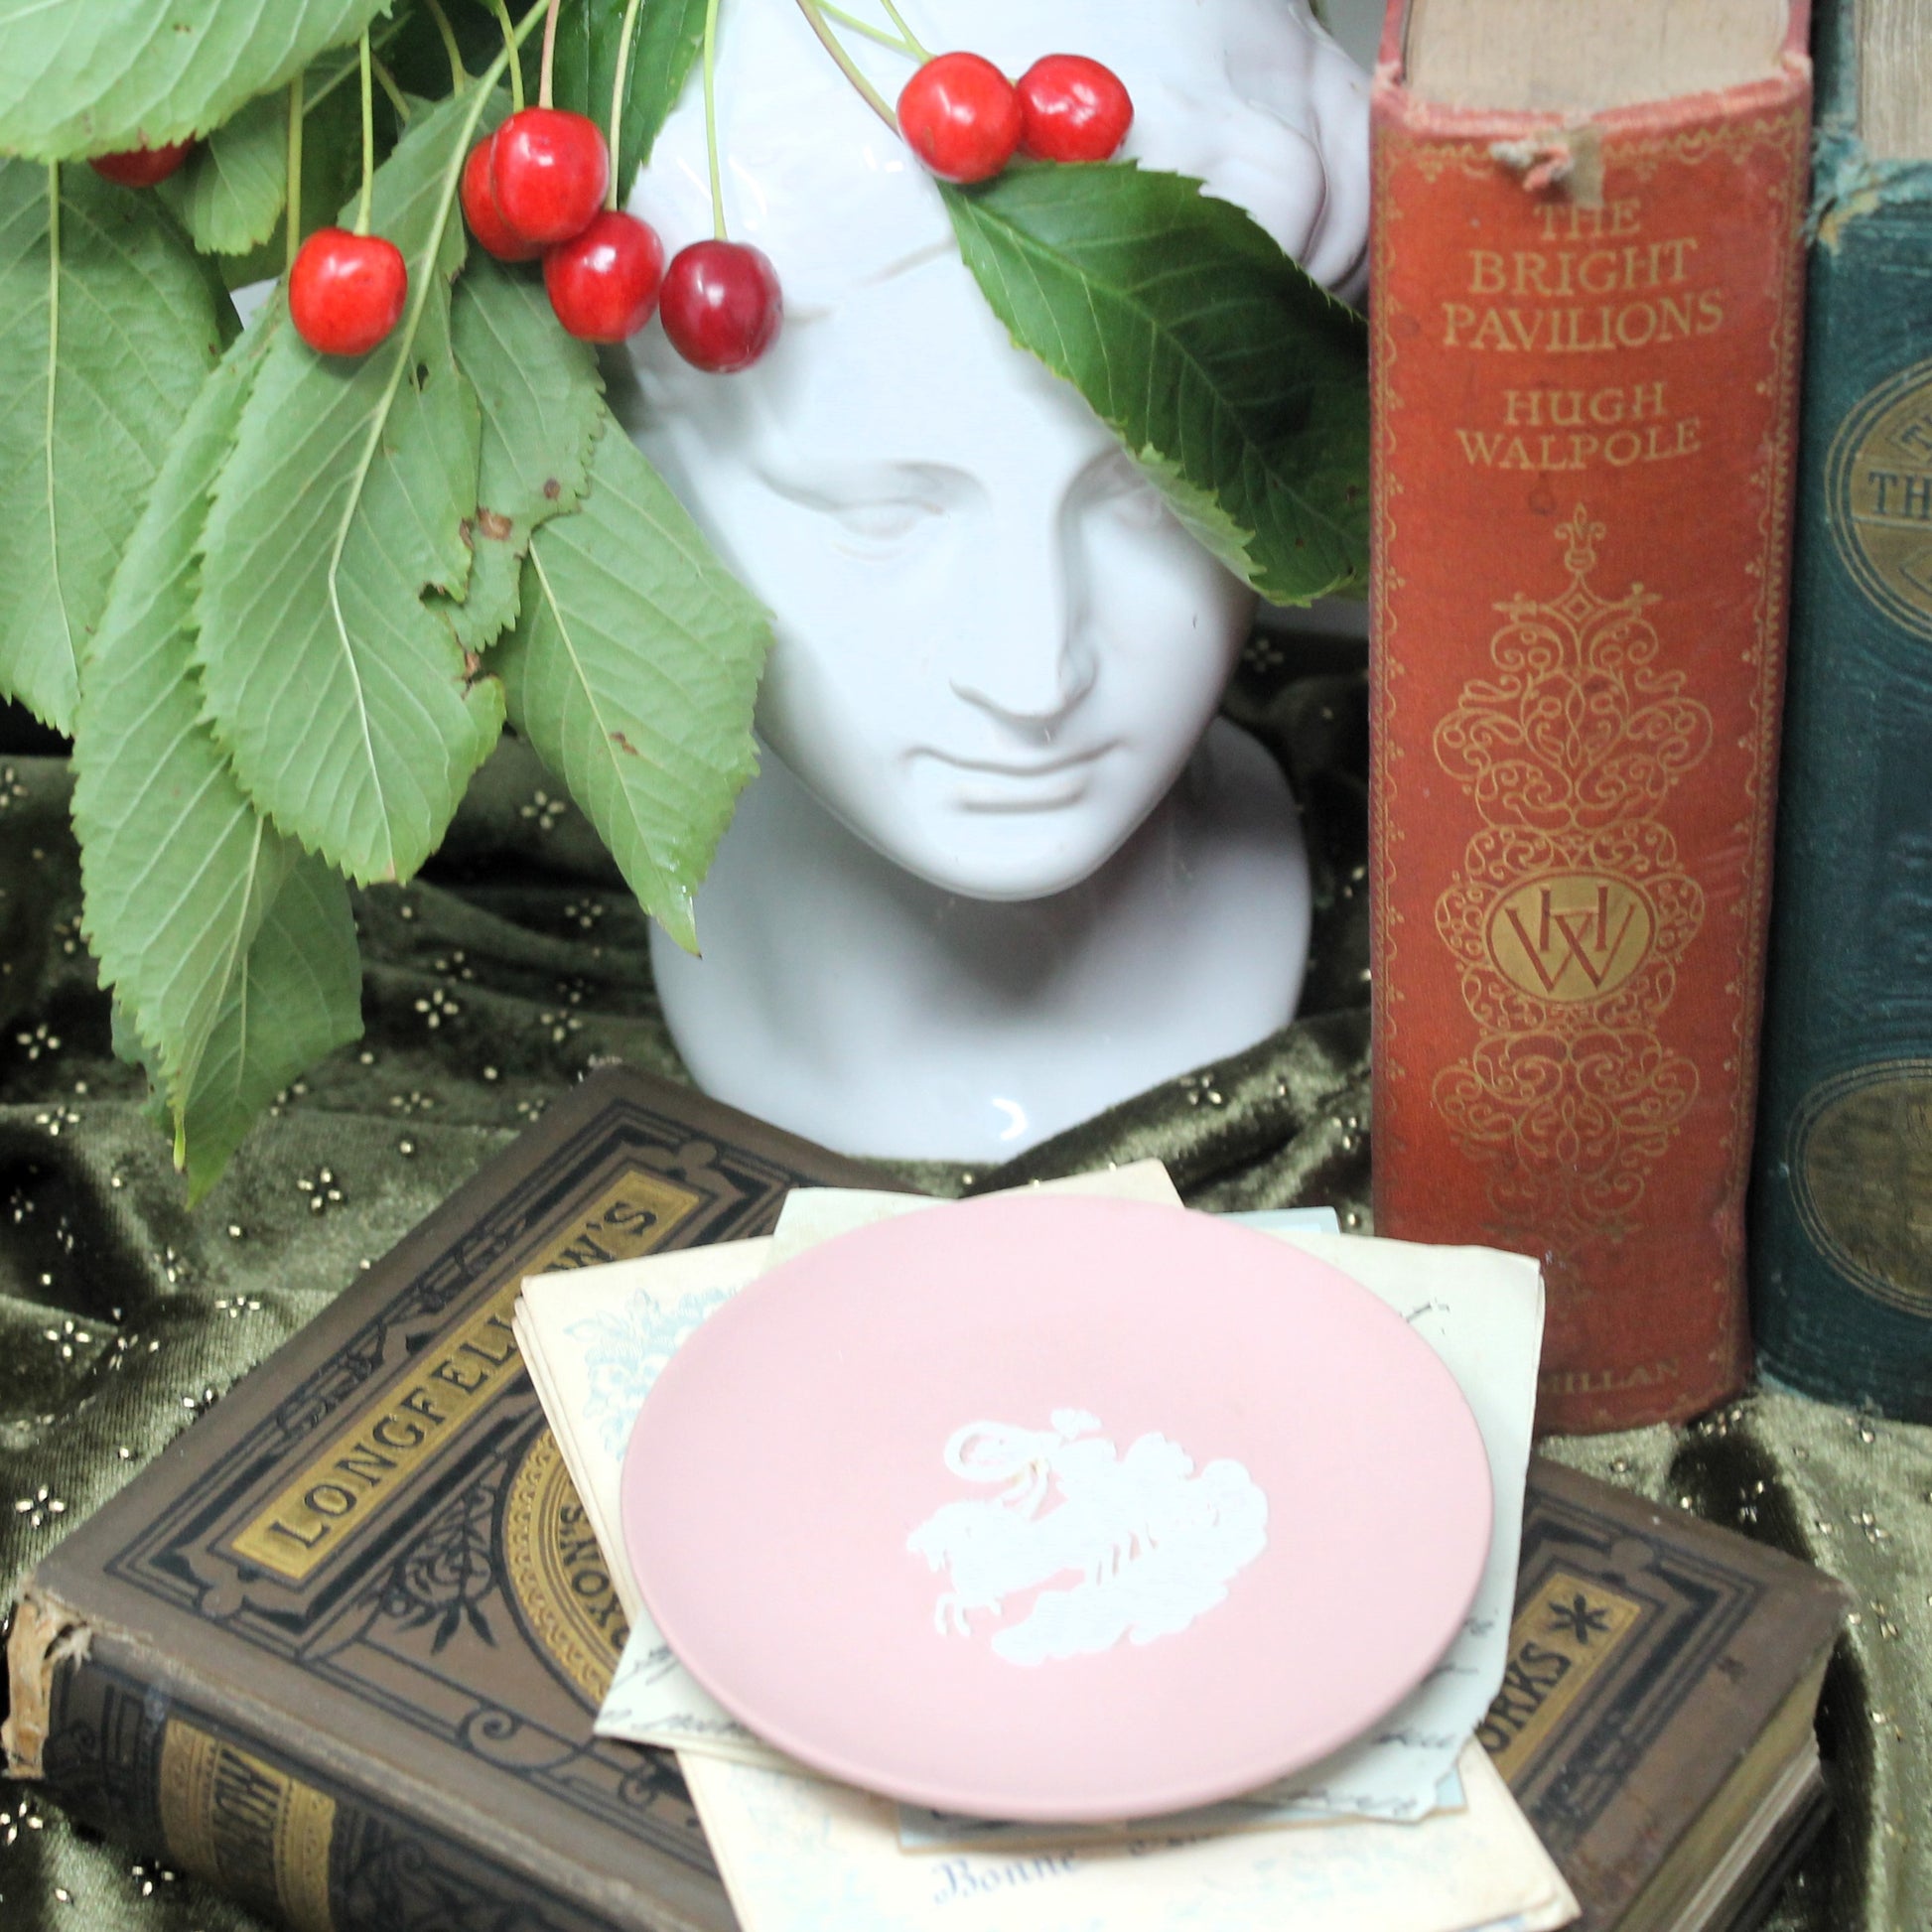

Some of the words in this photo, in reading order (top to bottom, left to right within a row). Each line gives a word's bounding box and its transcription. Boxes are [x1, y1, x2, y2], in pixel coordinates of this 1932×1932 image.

[1534, 198, 1642, 240] THE
[1469, 236, 1699, 296] BRIGHT
[1441, 288, 1724, 353] PAVILIONS
[1503, 381, 1668, 426] HUGH
[1455, 417, 1702, 471] WALPOLE
